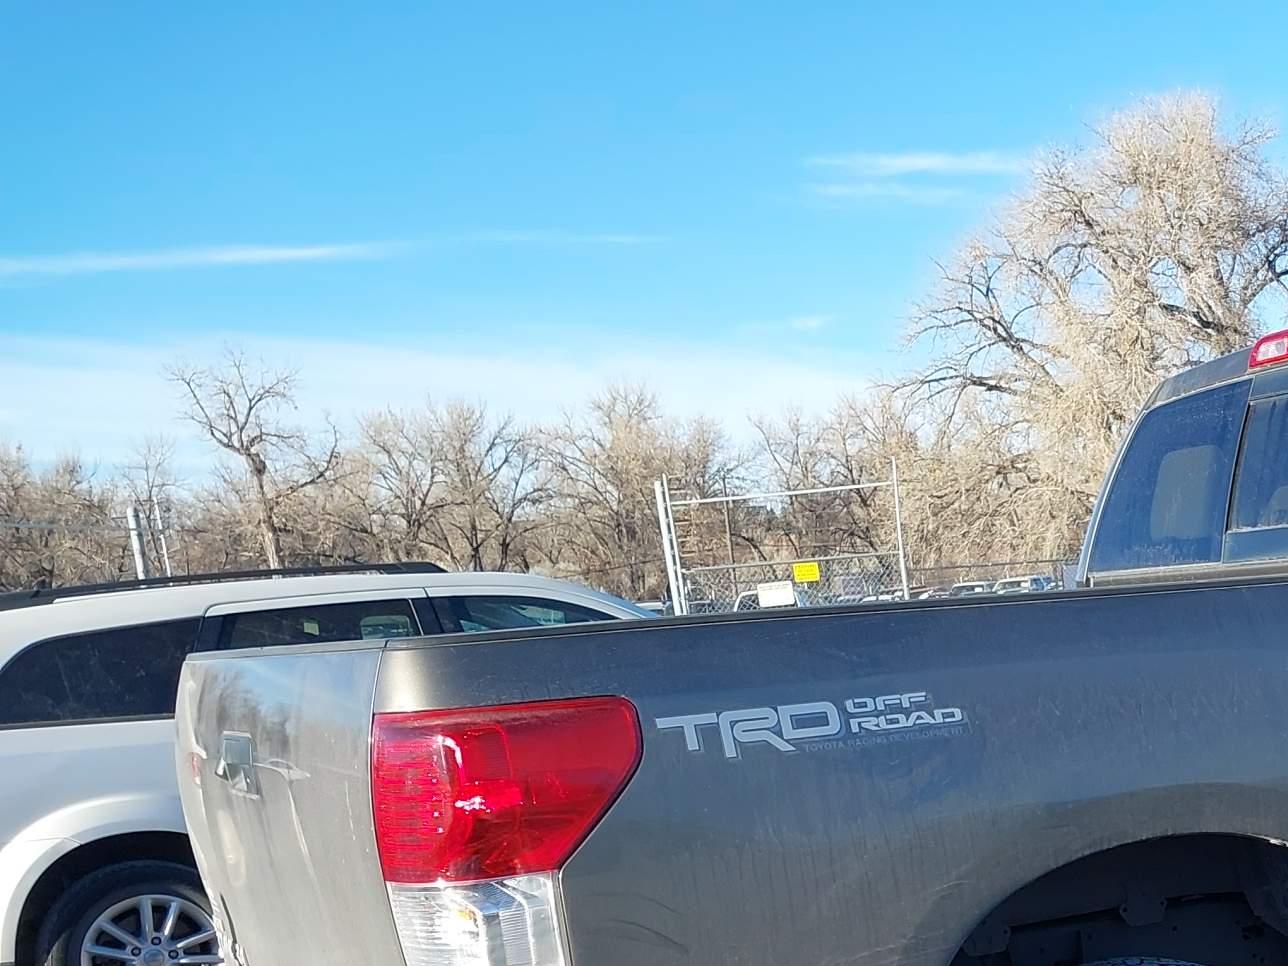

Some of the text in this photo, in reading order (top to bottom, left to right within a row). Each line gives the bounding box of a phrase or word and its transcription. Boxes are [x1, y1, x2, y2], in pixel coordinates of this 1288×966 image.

[844, 691, 929, 714] OFF
[655, 701, 842, 759] TRD
[849, 707, 964, 734] ROAD
